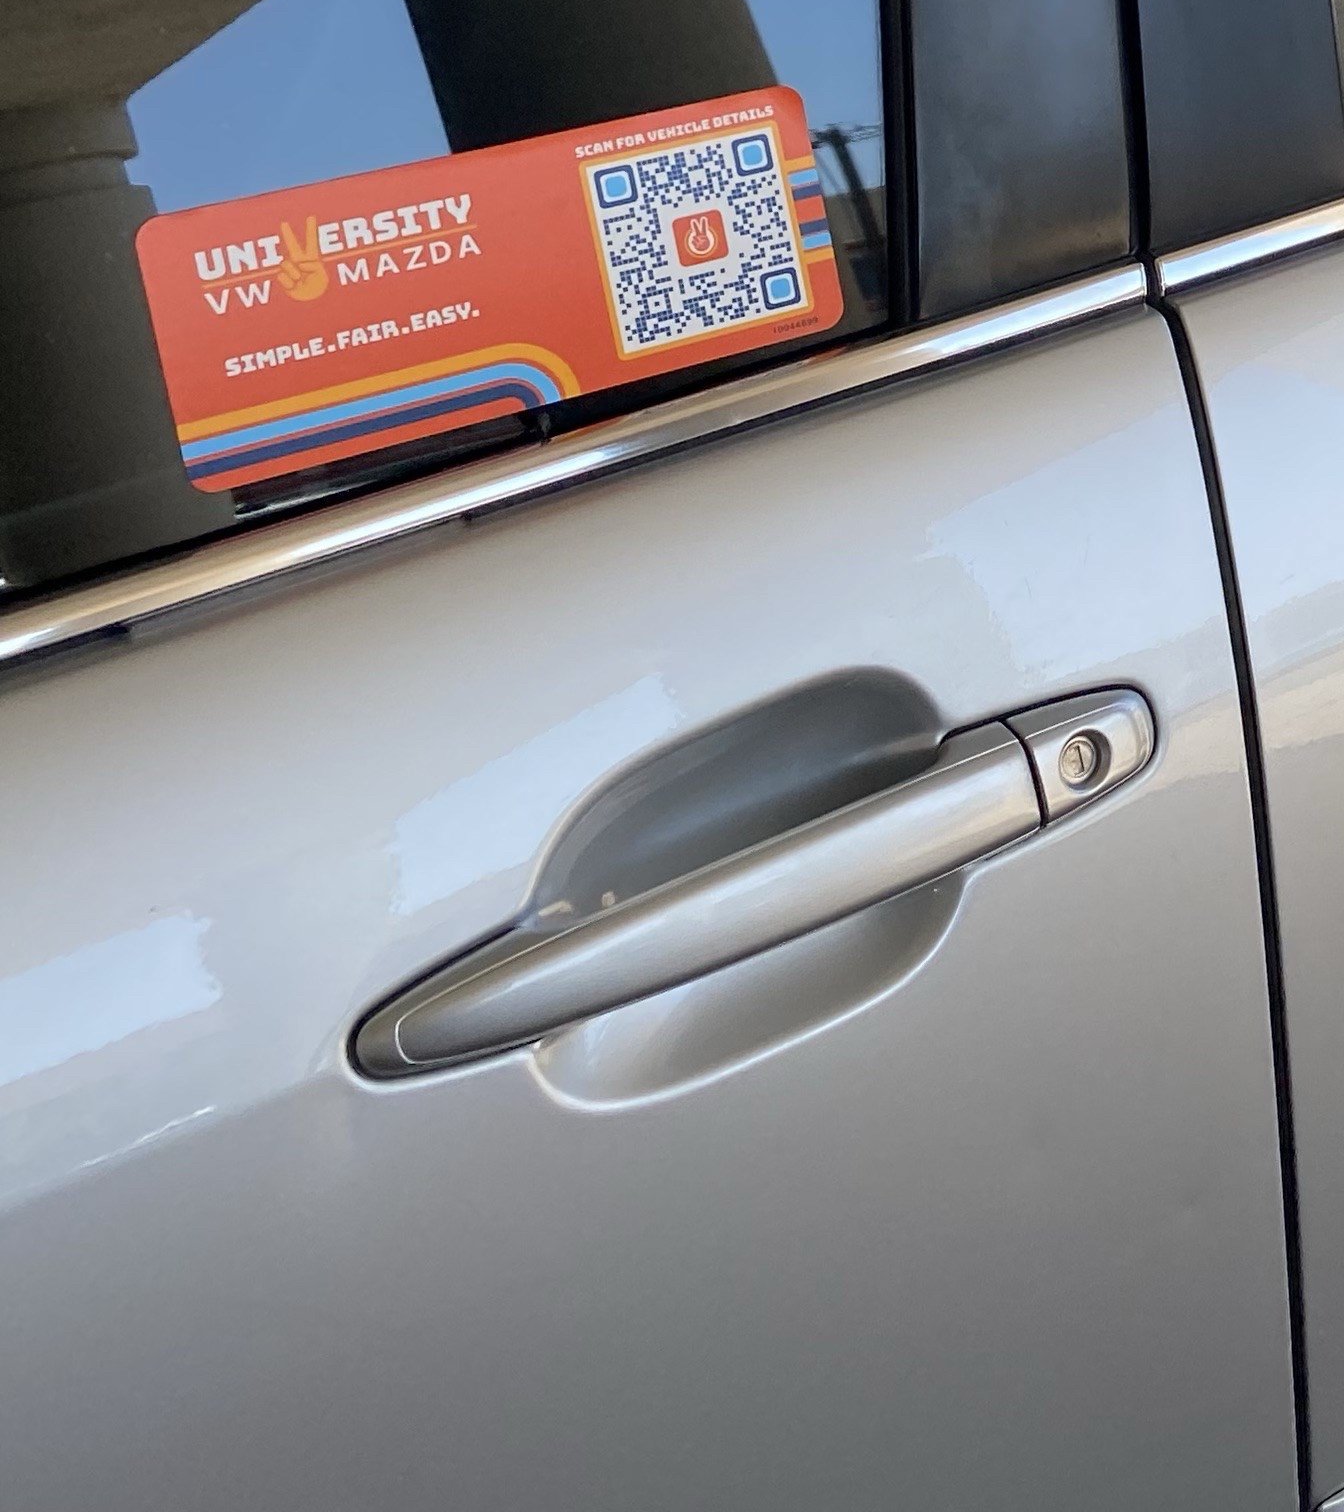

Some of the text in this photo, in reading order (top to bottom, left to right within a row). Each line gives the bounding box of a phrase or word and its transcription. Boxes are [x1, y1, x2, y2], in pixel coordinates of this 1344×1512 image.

[574, 104, 775, 160] SCAN FOR VEHICLE DETAILS
[193, 193, 475, 283] UNIVERSITY
[204, 233, 482, 317] VW MAZDA
[224, 301, 481, 378] SIMPLE.FAIR.EASY.
